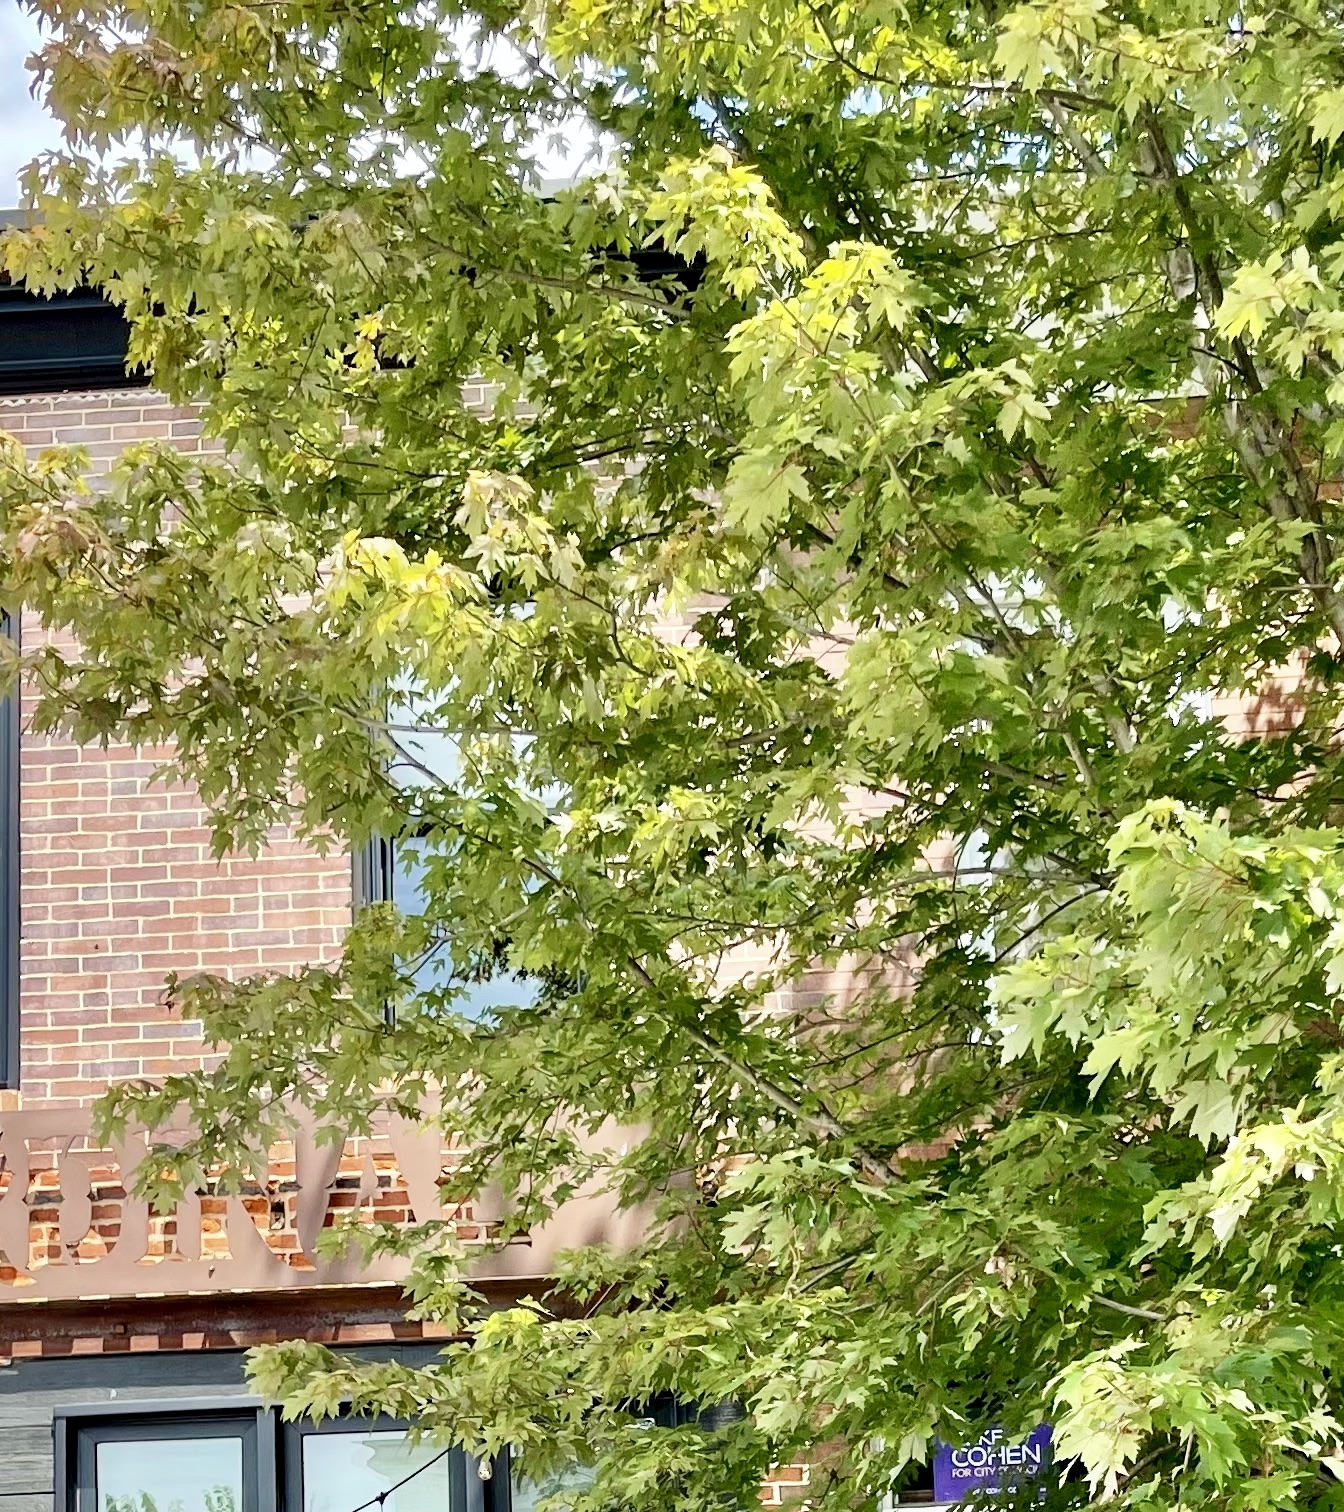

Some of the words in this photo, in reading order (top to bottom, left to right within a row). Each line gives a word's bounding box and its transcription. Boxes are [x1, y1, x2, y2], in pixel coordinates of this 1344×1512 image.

[951, 1443, 1041, 1468] COHEN
[951, 1468, 972, 1479] FOR
[973, 1466, 996, 1478] CITY
